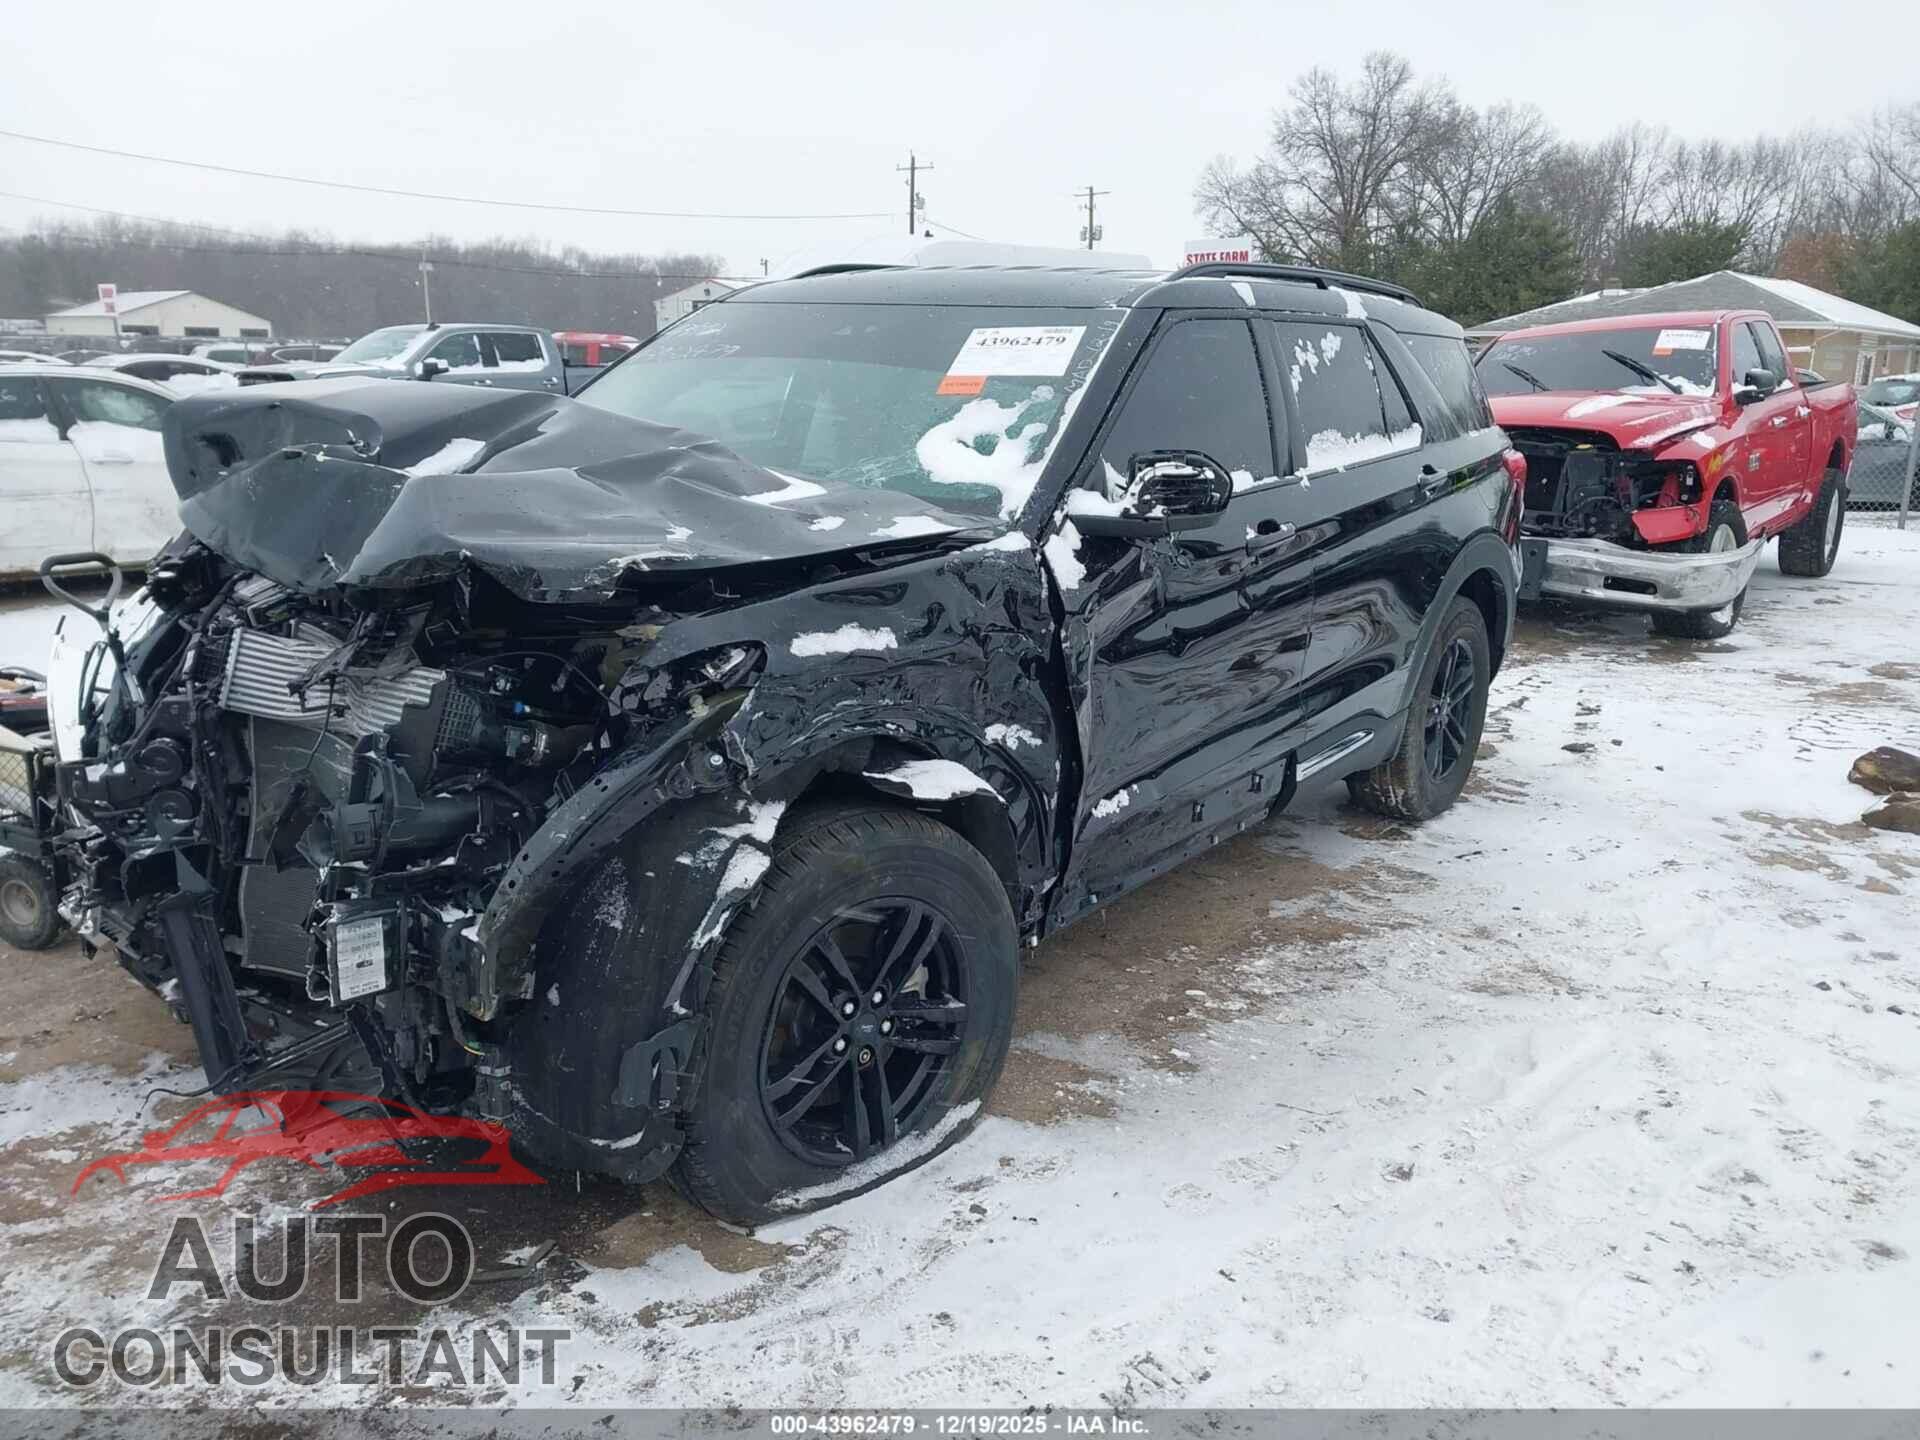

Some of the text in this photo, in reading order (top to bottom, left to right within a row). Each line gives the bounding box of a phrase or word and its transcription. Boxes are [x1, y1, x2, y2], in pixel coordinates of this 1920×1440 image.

[1186, 250, 1249, 265] STATE FARM
[975, 335, 1067, 347] 43962479
